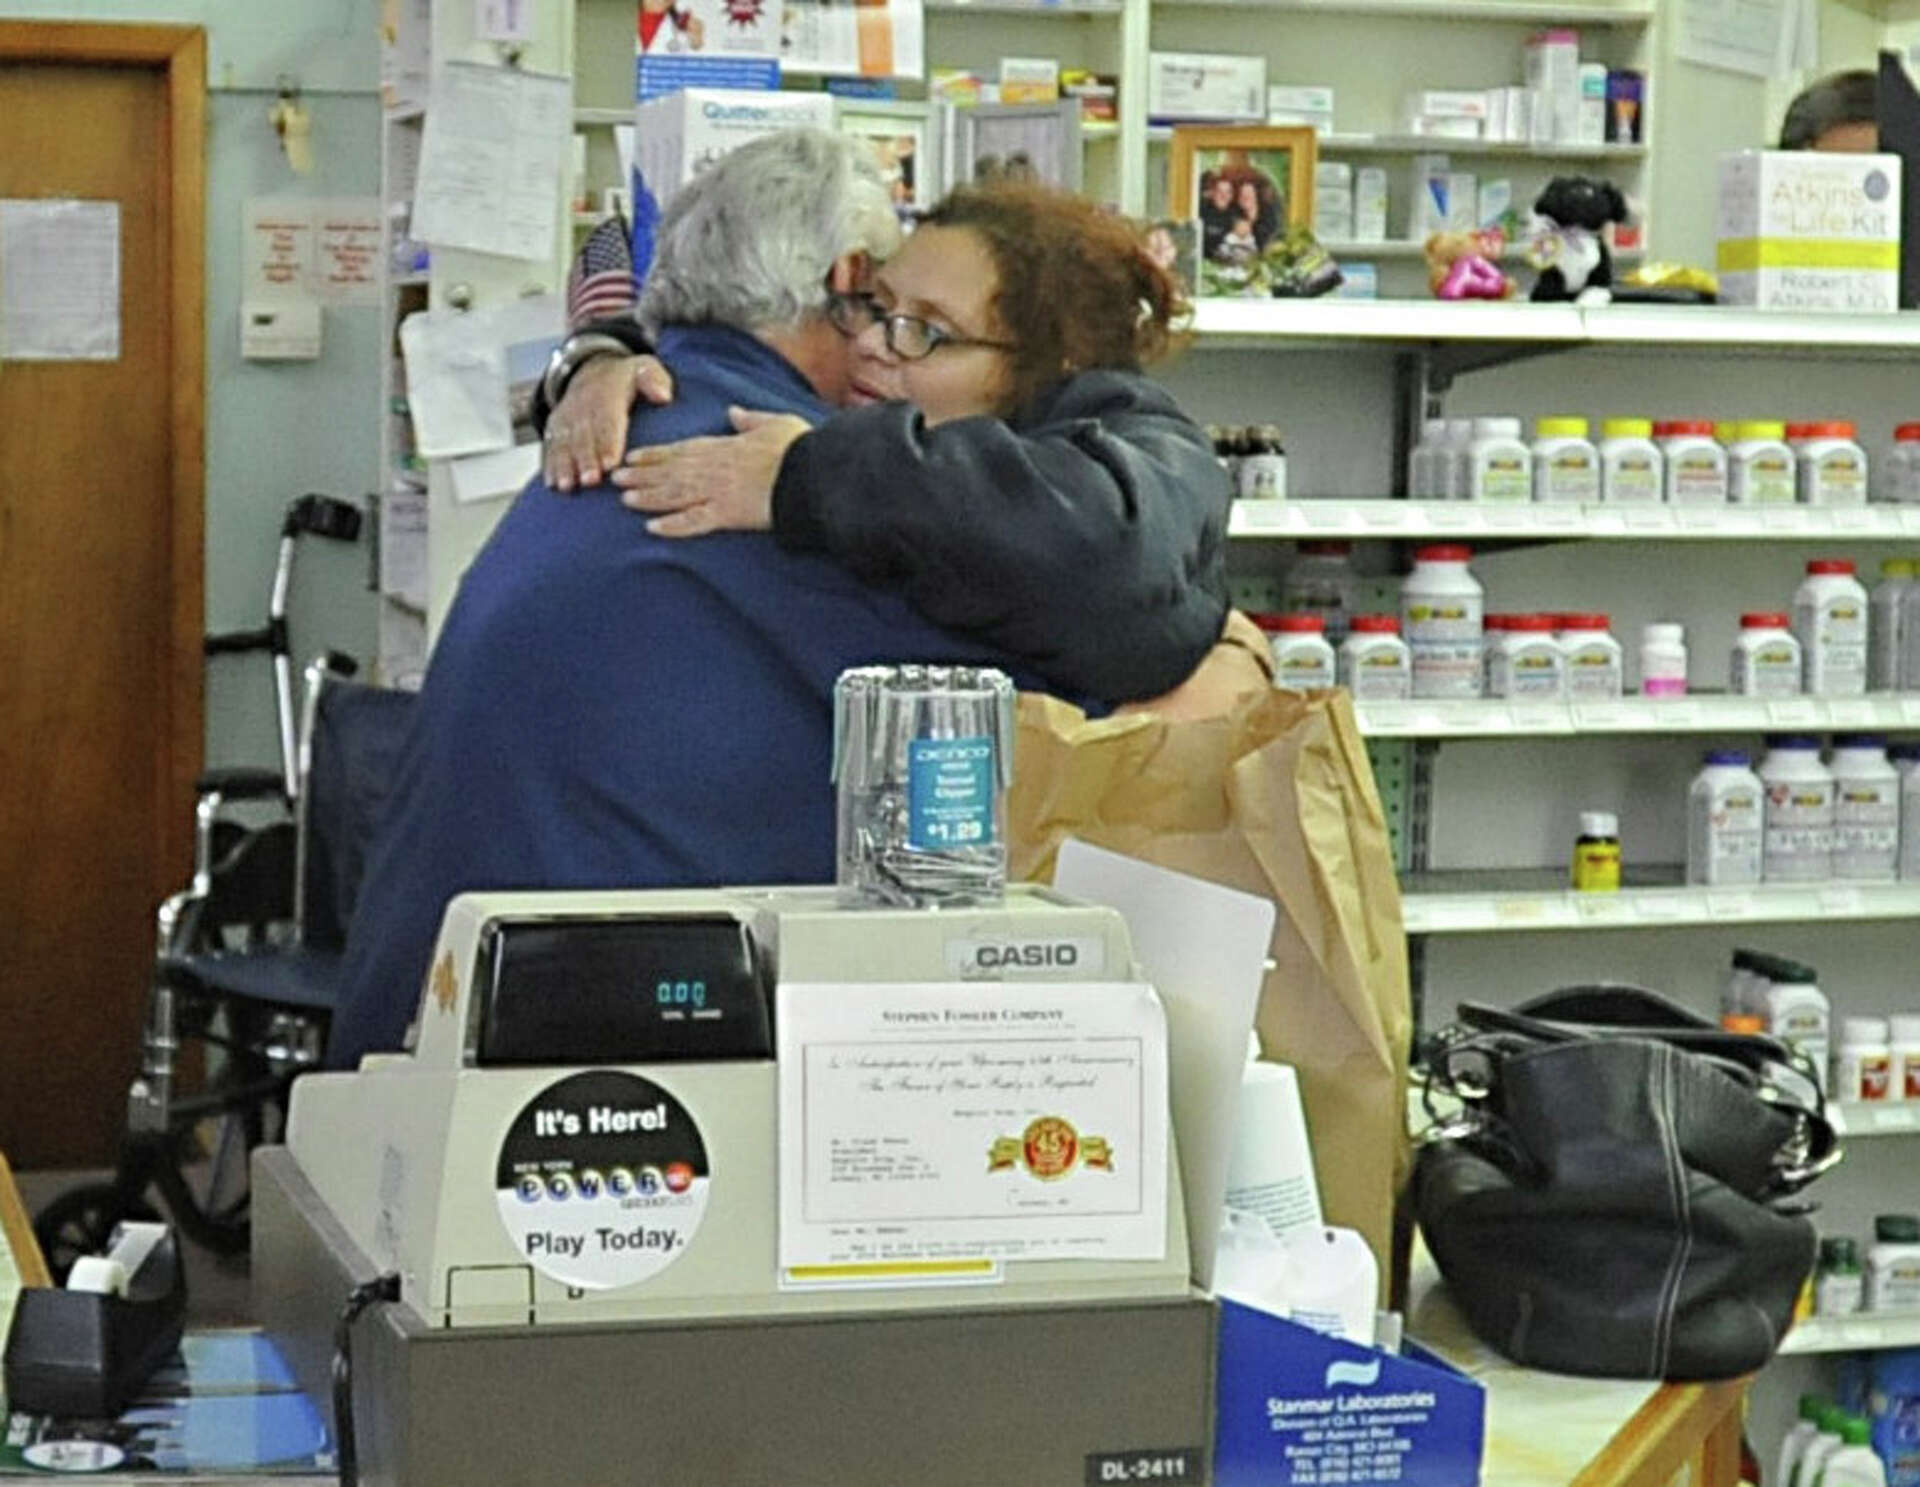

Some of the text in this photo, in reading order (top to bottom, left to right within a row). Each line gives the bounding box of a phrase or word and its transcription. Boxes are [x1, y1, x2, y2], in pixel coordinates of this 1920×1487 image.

[1772, 180, 1865, 206] Atkins
[976, 943, 1078, 968] CASIO
[1001, 1008, 1064, 1021] COMPANY
[535, 1102, 667, 1137] It's Here!
[526, 1226, 683, 1258] Play Today.
[1267, 1391, 1436, 1416] Stanmar Laboratories
[1101, 1457, 1185, 1481] DL-2411
